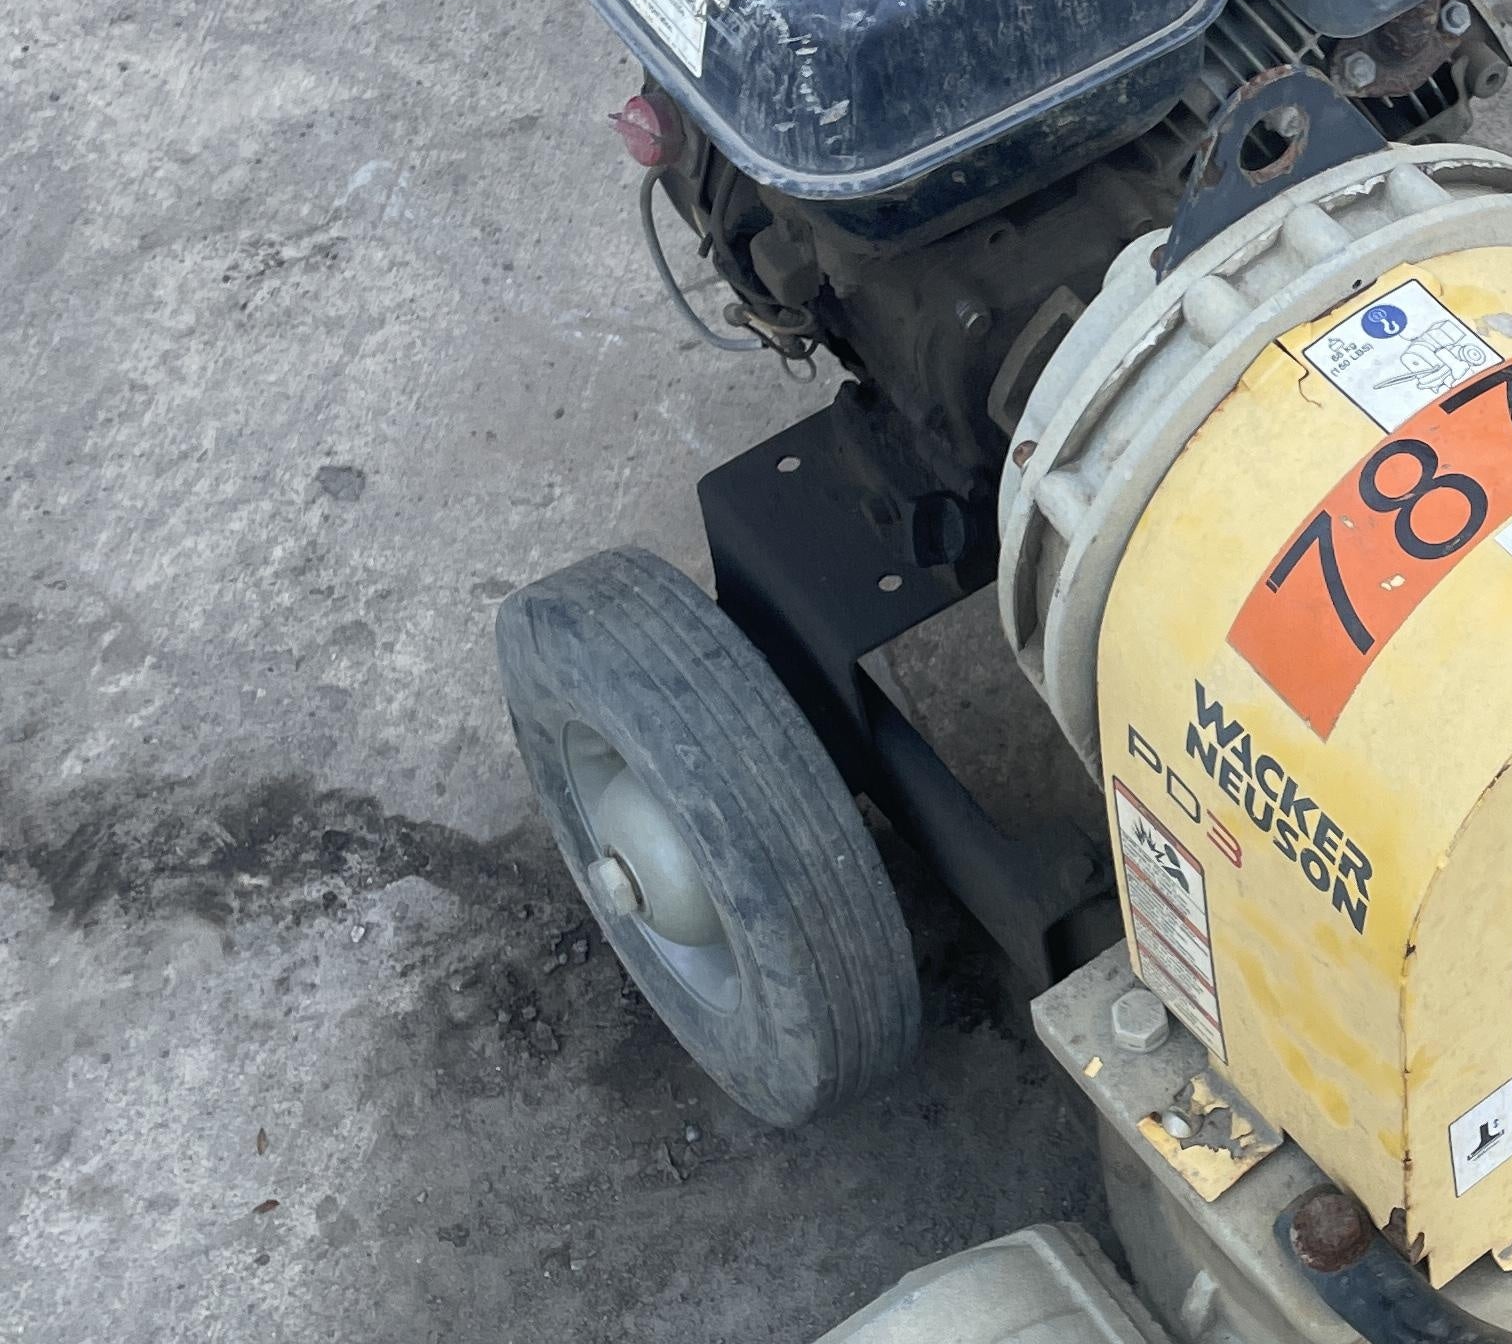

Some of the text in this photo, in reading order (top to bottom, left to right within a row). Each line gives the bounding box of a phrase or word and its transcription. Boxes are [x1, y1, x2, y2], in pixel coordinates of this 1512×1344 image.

[1129, 724, 1243, 869] PD3
[1186, 722, 1368, 935] NEUSON
[1195, 678, 1373, 901] WACKER
